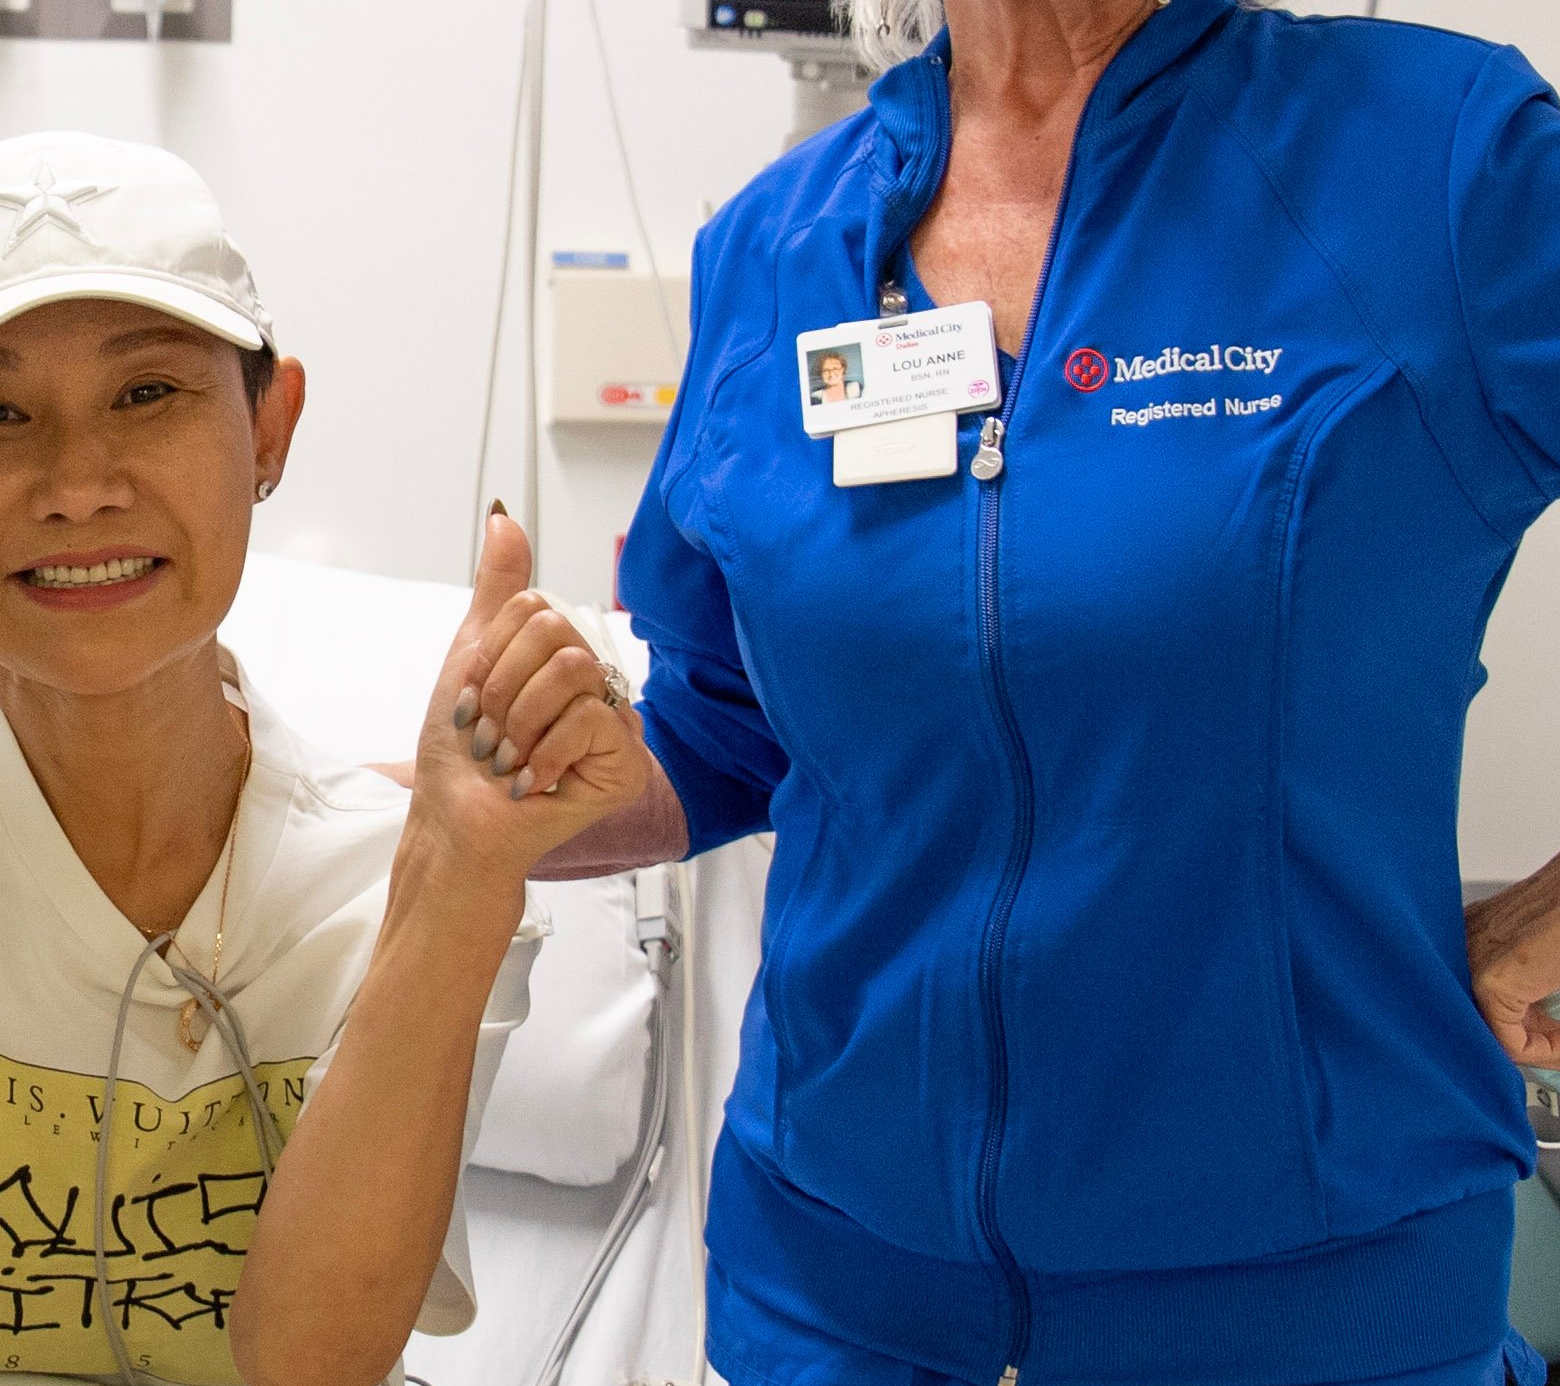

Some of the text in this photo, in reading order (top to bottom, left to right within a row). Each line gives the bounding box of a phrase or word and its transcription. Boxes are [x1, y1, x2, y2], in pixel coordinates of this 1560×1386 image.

[895, 322, 963, 342] Medical City
[892, 349, 967, 373] LOU ANNE
[1112, 344, 1284, 384] Medical City
[935, 368, 950, 377] RN
[849, 386, 949, 411] REGISTERED NURSE
[872, 402, 929, 419] APHERESIS
[1110, 393, 1283, 427] Registered Nurse
[4, 1354, 21, 1370] 8
[137, 1354, 152, 1368] 5
